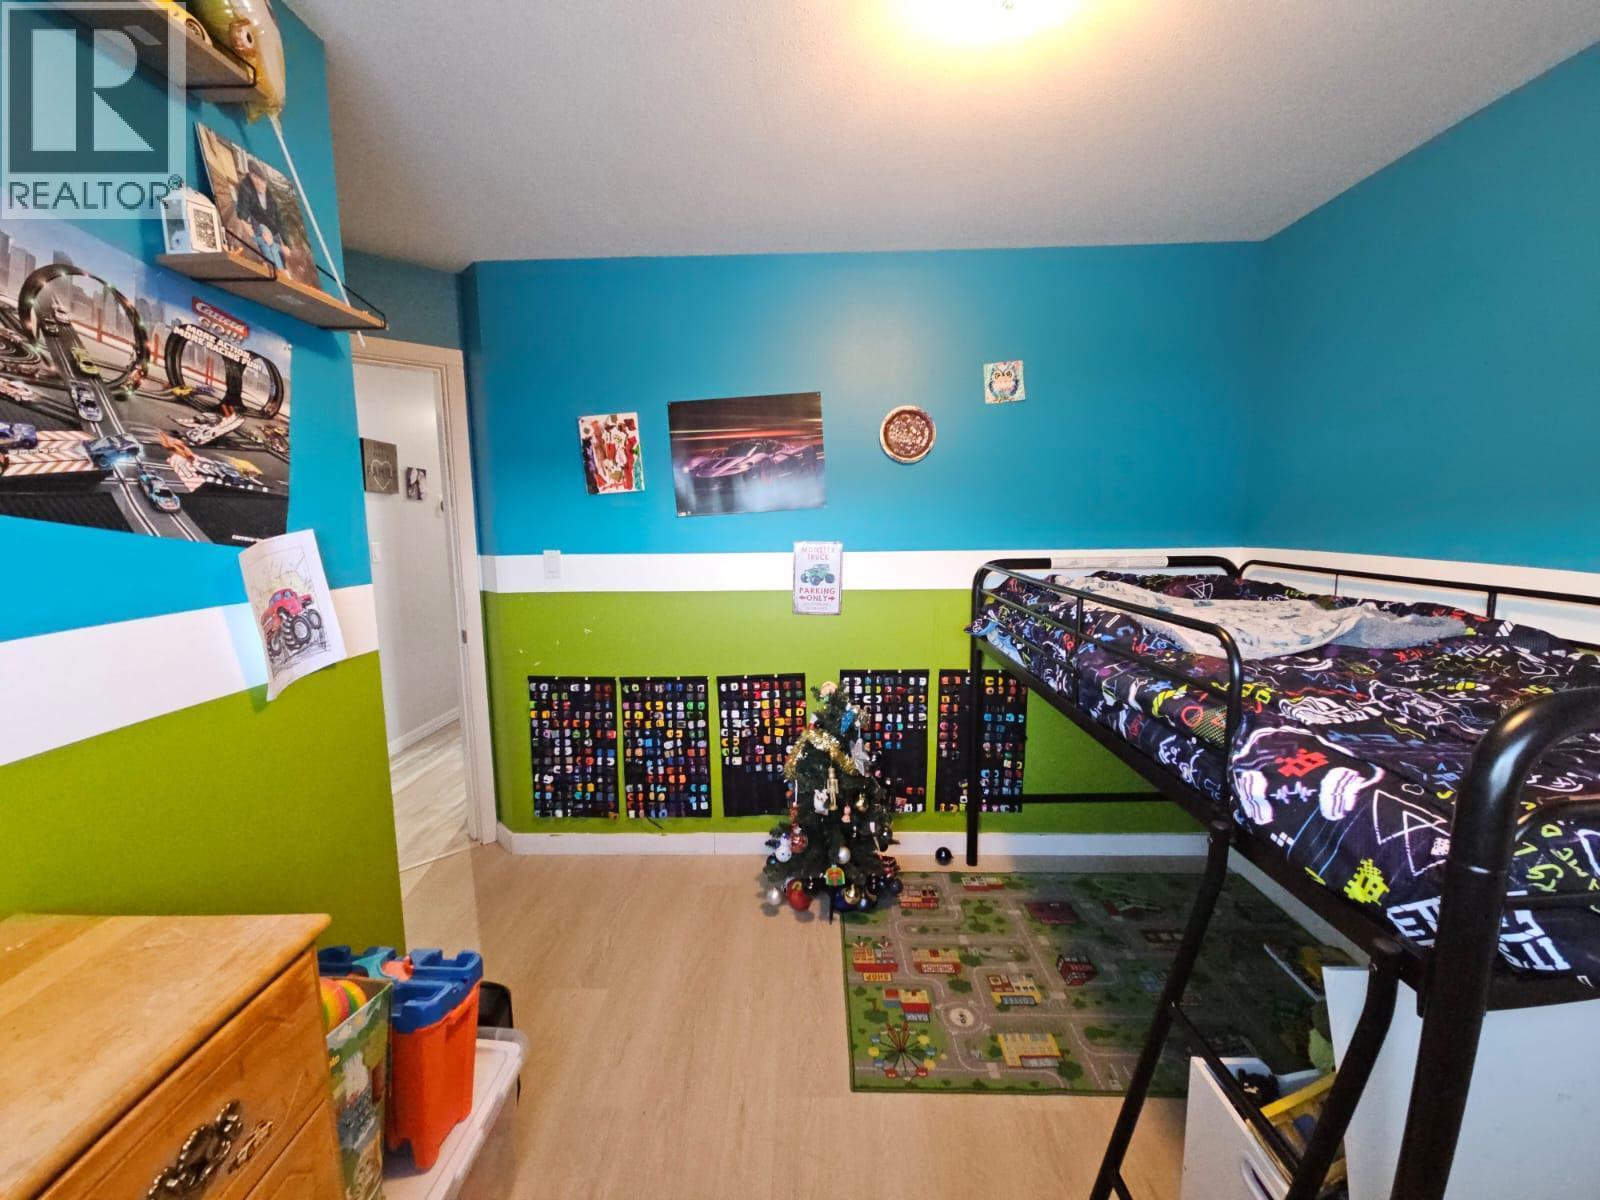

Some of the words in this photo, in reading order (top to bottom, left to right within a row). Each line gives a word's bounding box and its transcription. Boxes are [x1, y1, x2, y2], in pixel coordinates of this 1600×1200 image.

[195, 302, 246, 333] Carrera
[186, 324, 217, 344] MORE
[173, 326, 204, 346] MORE
[206, 341, 241, 362] RACING
[806, 594, 827, 602] ONLY
[865, 973, 889, 981] SHOP
[905, 1013, 929, 1021] BANK
